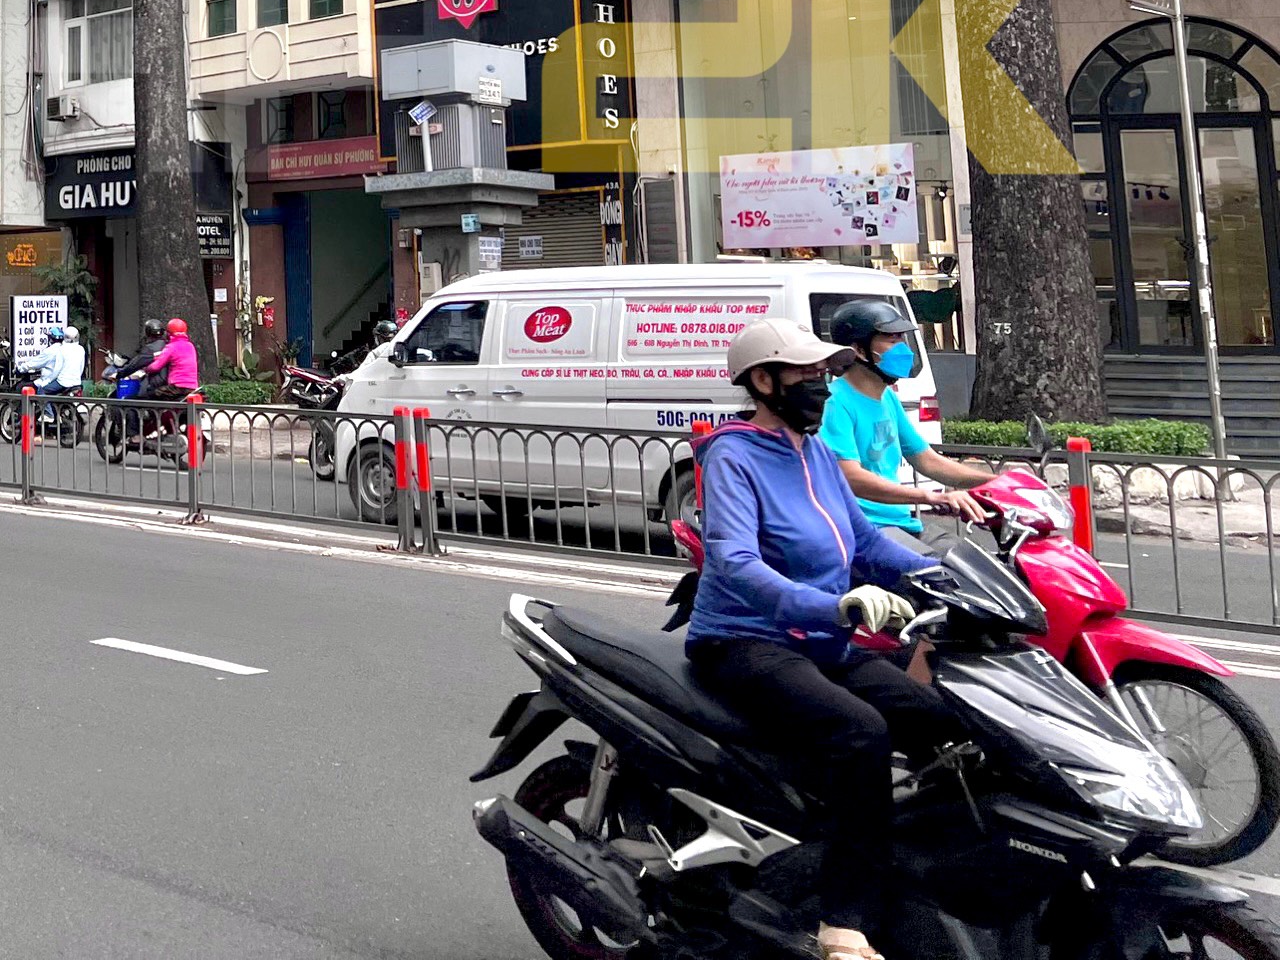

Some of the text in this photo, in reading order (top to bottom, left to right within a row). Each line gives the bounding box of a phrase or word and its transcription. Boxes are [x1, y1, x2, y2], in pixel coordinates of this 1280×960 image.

[77, 155, 132, 174] PHÒNG CHO
[299, 155, 312, 166] HUY
[59, 184, 96, 209] GIA
[730, 210, 771, 227] -15%
[22, 300, 34, 308] GIA
[726, 304, 743, 313] TOP
[19, 310, 63, 324] HOTEL
[535, 312, 560, 326] Top
[532, 324, 566, 337] Meat
[637, 323, 677, 333] HOTLINE:
[994, 323, 1012, 334] 75
[521, 369, 539, 378] CUNG
[1009, 838, 1068, 863] HONDA
